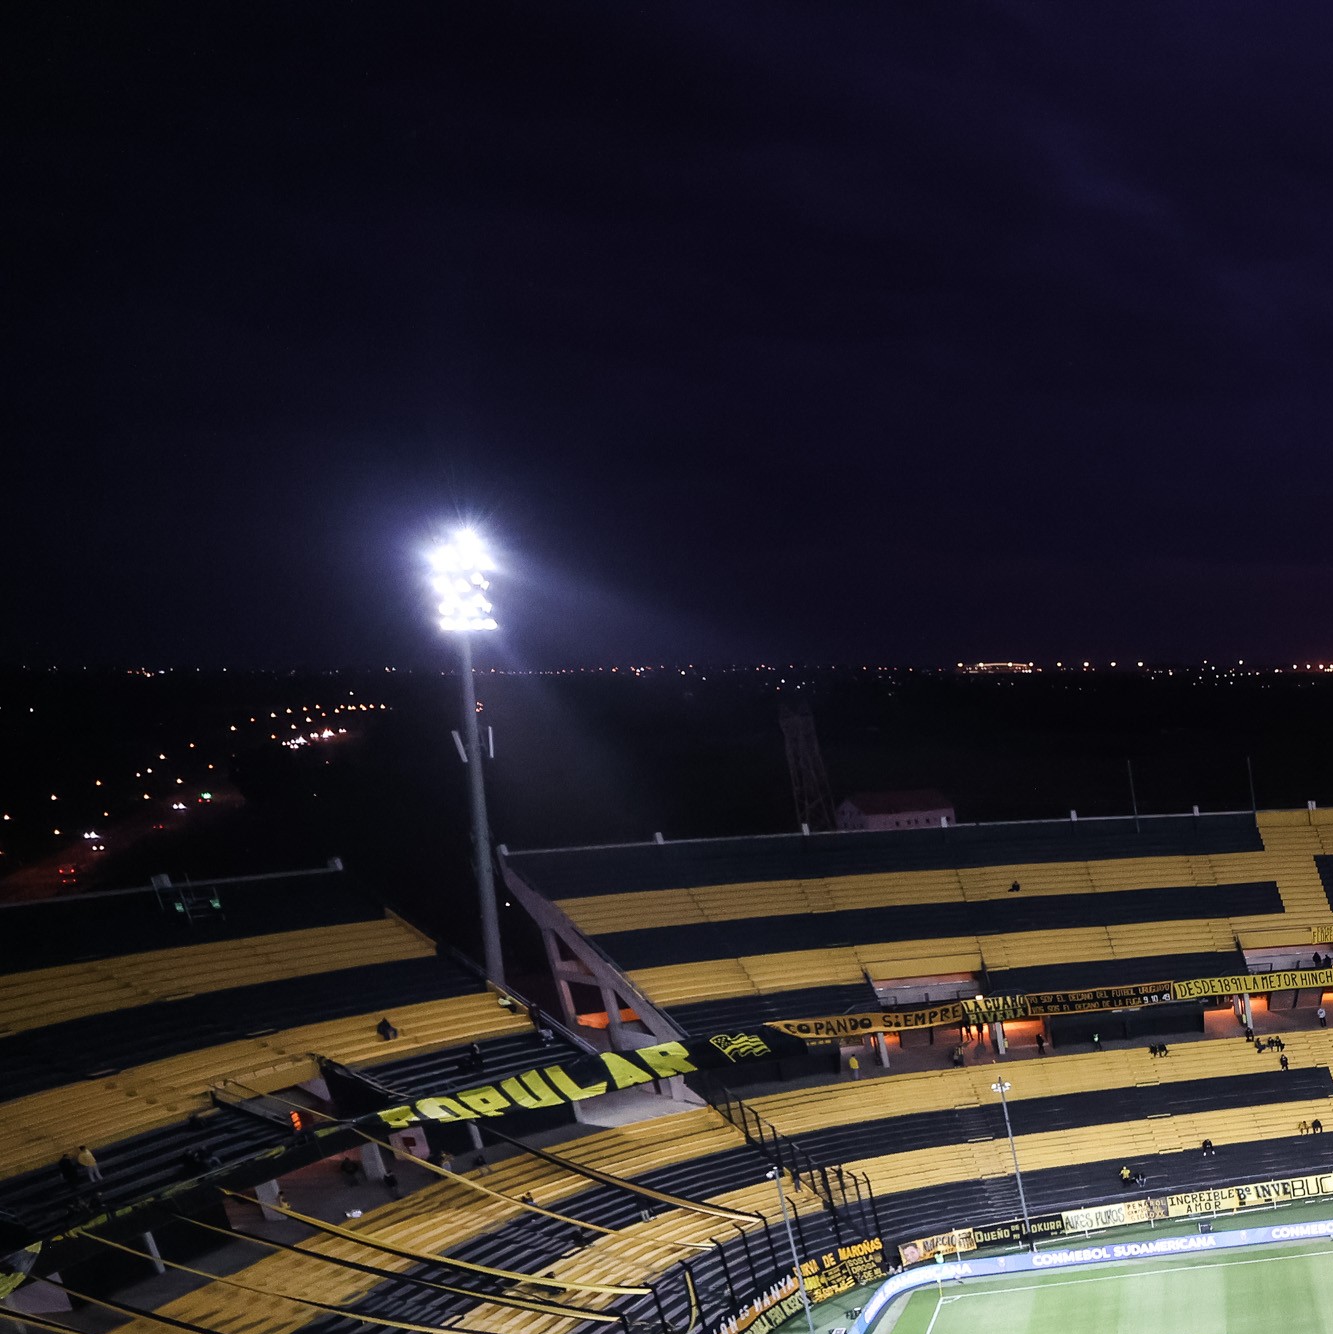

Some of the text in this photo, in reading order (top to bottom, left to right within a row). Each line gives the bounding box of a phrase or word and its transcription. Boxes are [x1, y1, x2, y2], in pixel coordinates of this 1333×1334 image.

[1179, 978, 1219, 998] DESDE
[1218, 975, 1244, 993] 1891
[1243, 974, 1260, 992] LA
[1260, 971, 1299, 990] MEJOR
[1040, 994, 1054, 1004] SOY
[1111, 987, 1136, 998] FUTBOL
[783, 1015, 873, 1036] COPANDO
[969, 1008, 1026, 1024] RIVERA
[1168, 1188, 1236, 1206] INCREIBLE
[1096, 1206, 1125, 1227] PUROS
[1186, 1201, 1222, 1214] AMOR
[974, 1228, 1010, 1243] DUEÑO
[822, 1237, 884, 1268] DE MAROÑAS
[1032, 1235, 1217, 1266] CONMEBOL SUDAMERICANA
[851, 1262, 877, 1275] DROGA
[753, 1275, 795, 1312] MANYA
